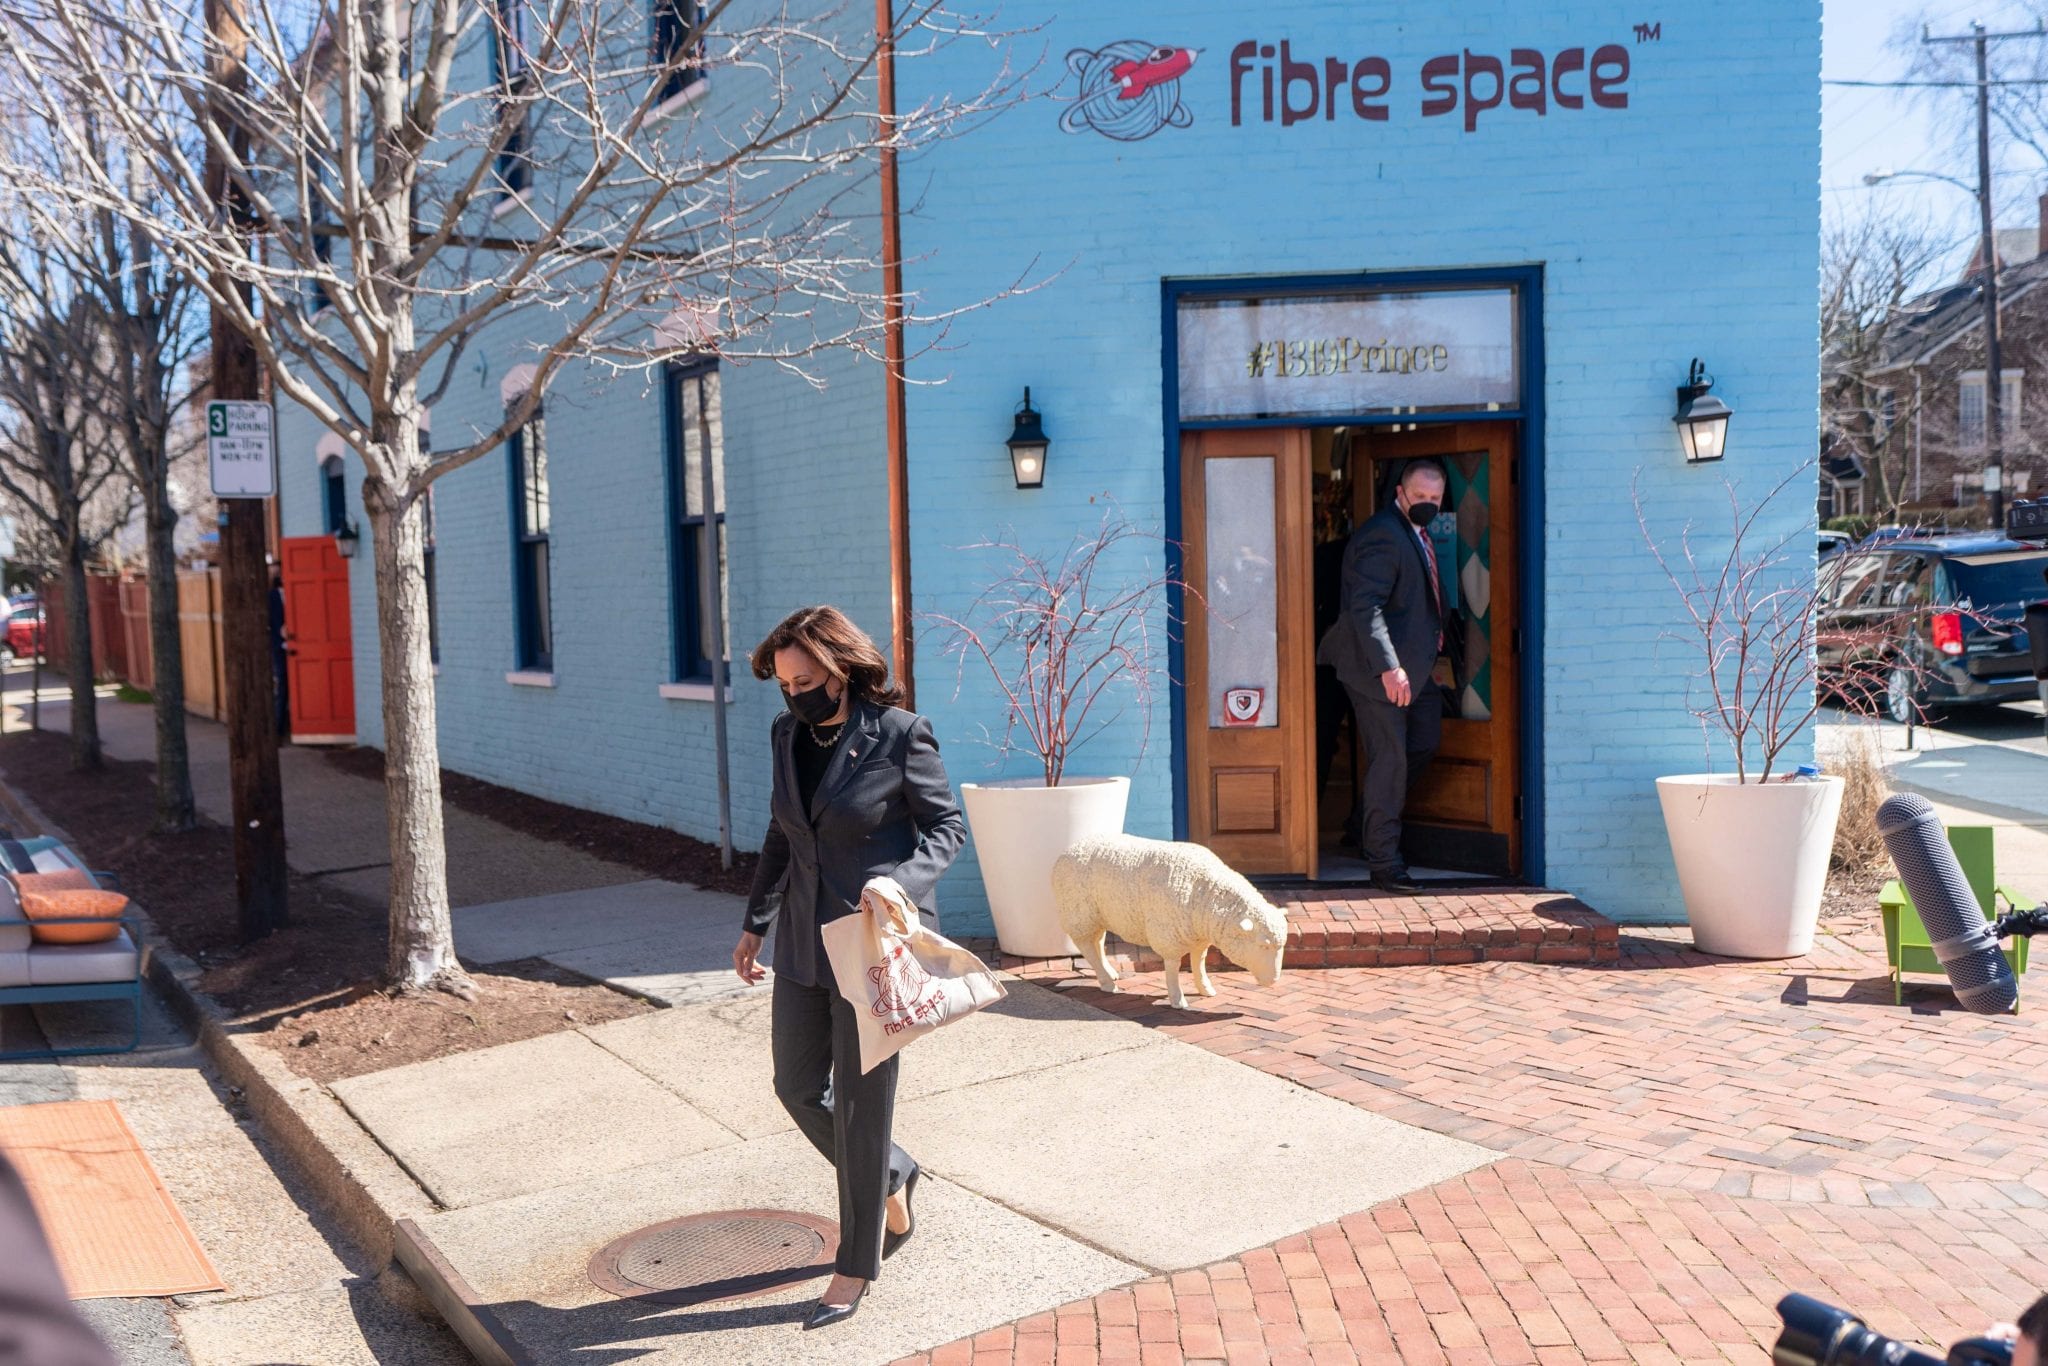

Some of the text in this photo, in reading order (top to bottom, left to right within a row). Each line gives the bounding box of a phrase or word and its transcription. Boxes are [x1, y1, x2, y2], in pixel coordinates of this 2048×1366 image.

[1231, 39, 1392, 126] fibre
[1421, 44, 1631, 132] space
[1246, 336, 1449, 377] #1319Prince
[211, 407, 256, 432] 3 HOUR
[229, 423, 269, 431] PARKING
[884, 989, 945, 1036] fibre space
